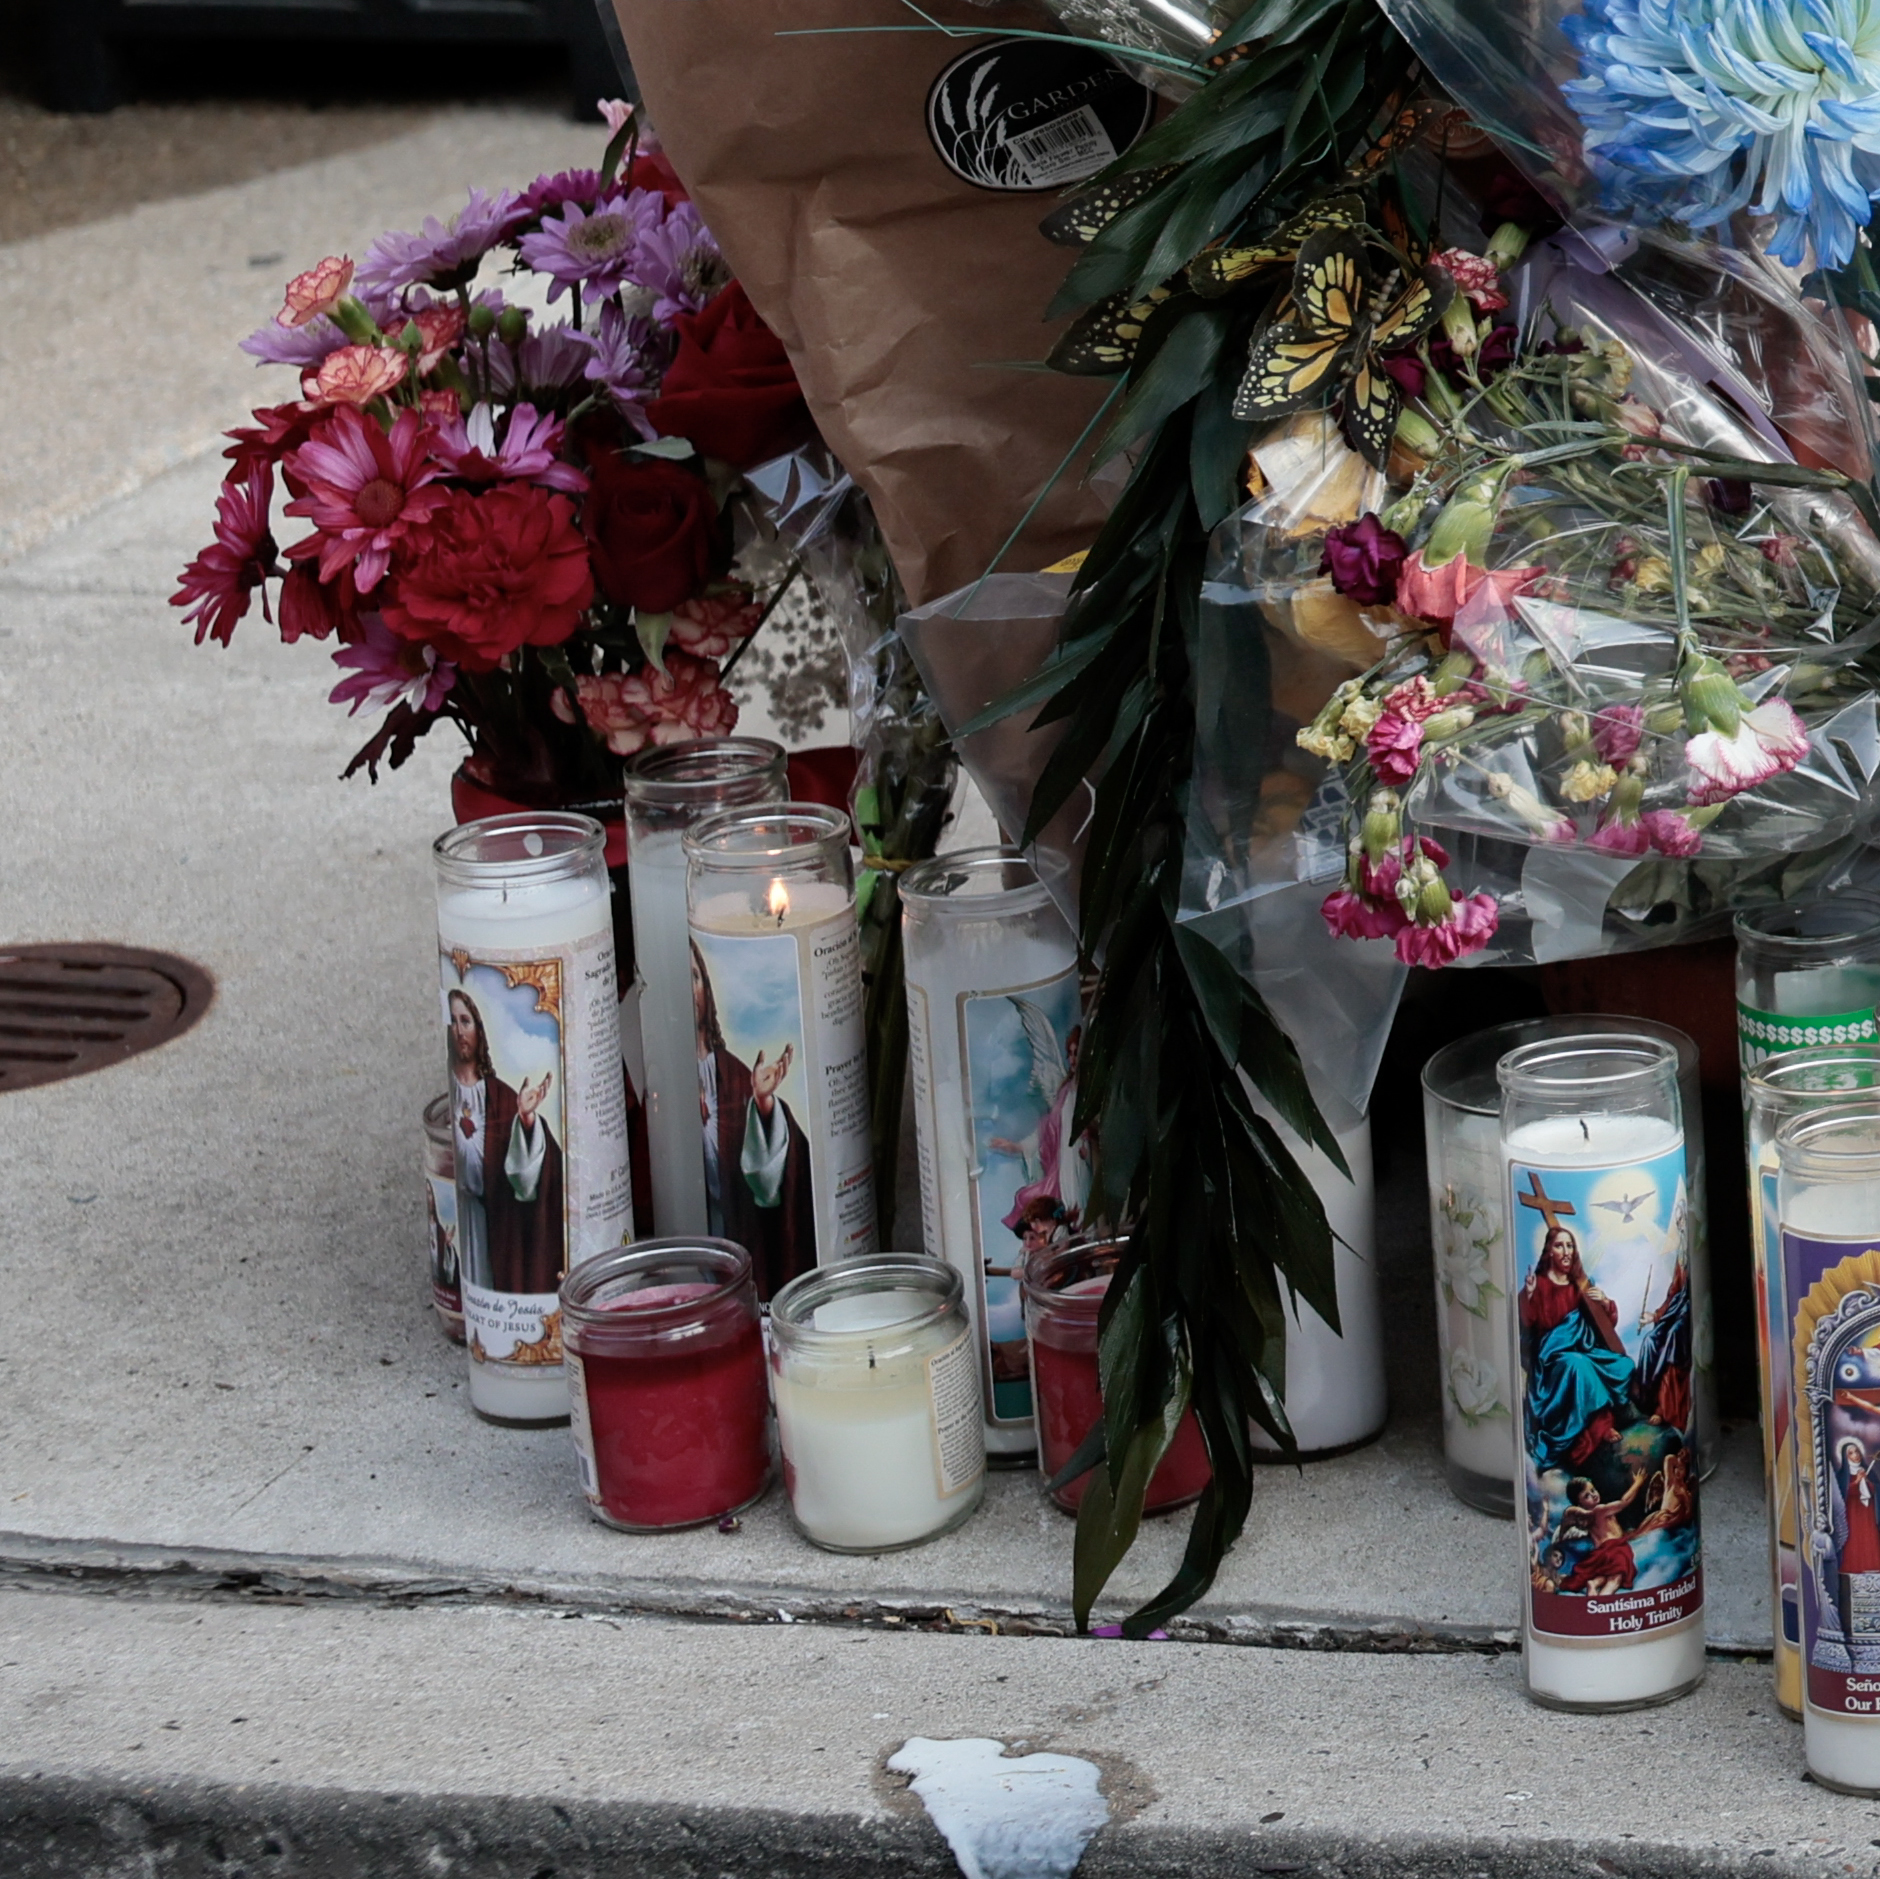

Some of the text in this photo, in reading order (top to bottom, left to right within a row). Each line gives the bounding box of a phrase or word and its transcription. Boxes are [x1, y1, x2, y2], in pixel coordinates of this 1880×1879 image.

[825, 1056, 853, 1076] Prayer
[493, 1302, 504, 1313] de
[508, 1299, 545, 1319] Jesús
[488, 1319, 500, 1330] OF
[502, 1321, 536, 1333] JESUS
[1587, 1576, 1696, 1614] Santísima Trinidad
[1610, 1606, 1682, 1631] Holy Trinity
[1845, 1696, 1872, 1710] Our
